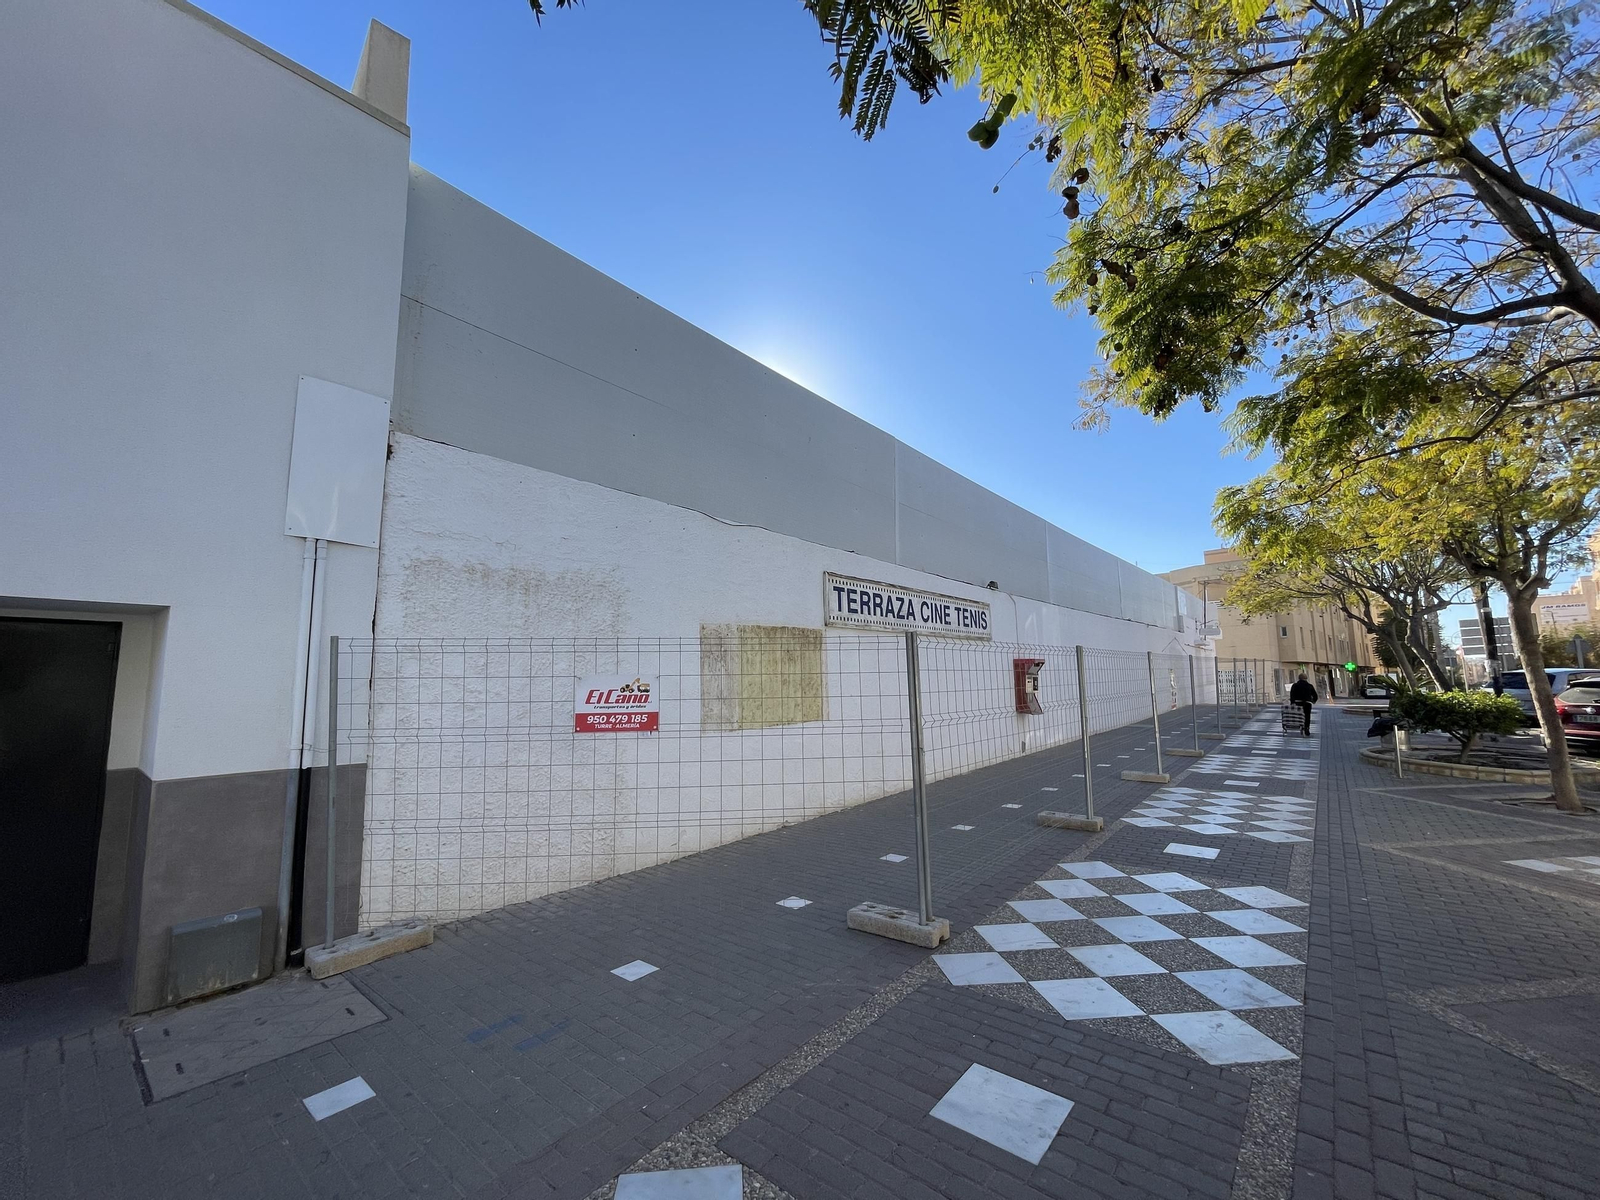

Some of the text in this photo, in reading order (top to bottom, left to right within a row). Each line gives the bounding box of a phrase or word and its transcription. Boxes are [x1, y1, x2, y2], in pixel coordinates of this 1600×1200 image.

[833, 586, 988, 630] TERRAZA CINE TENIS
[587, 714, 648, 724] 950 479 185
